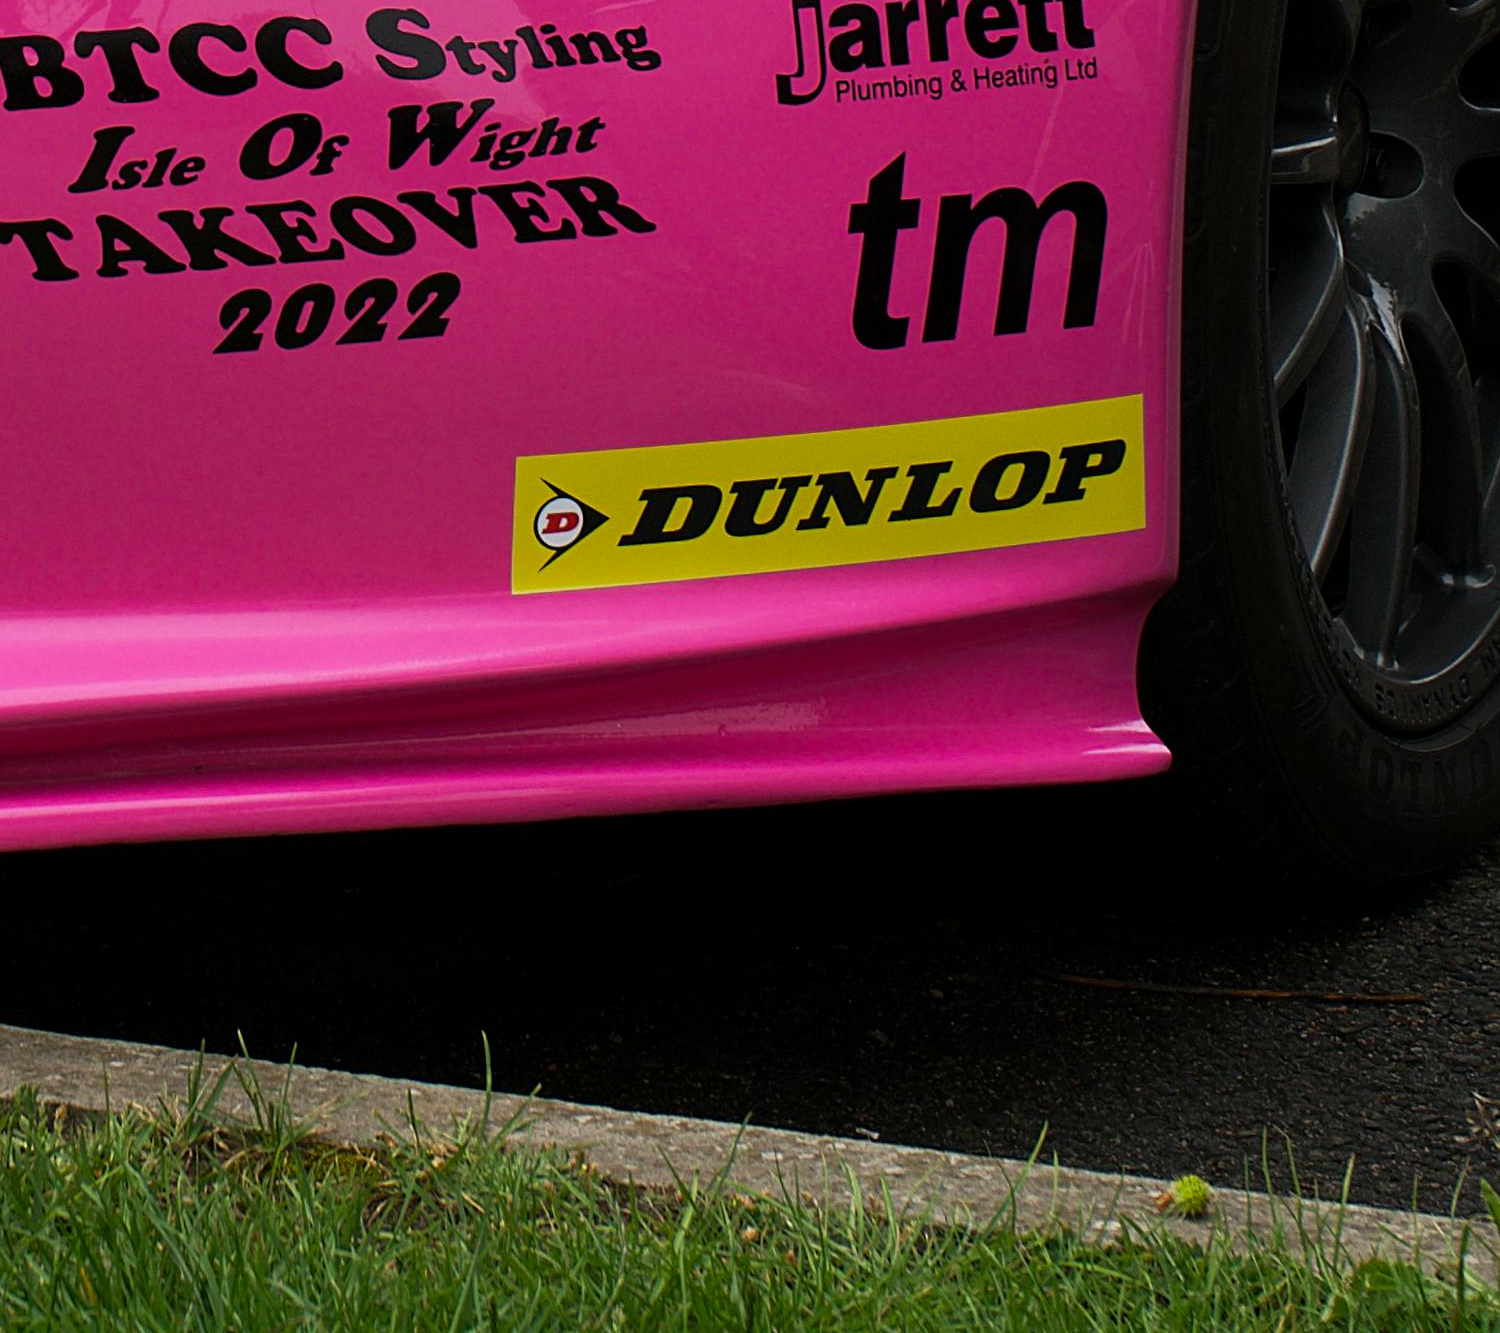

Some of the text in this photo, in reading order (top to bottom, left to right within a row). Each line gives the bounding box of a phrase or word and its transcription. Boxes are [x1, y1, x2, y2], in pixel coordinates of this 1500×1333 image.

[364, 8, 662, 83] Styling
[835, 57, 1098, 103] Plumbing & Heating Ltd
[67, 97, 607, 194] Isle Of Wight
[848, 150, 1108, 351] tm
[212, 271, 462, 354] 2022
[616, 438, 1127, 547] DUNLOP
